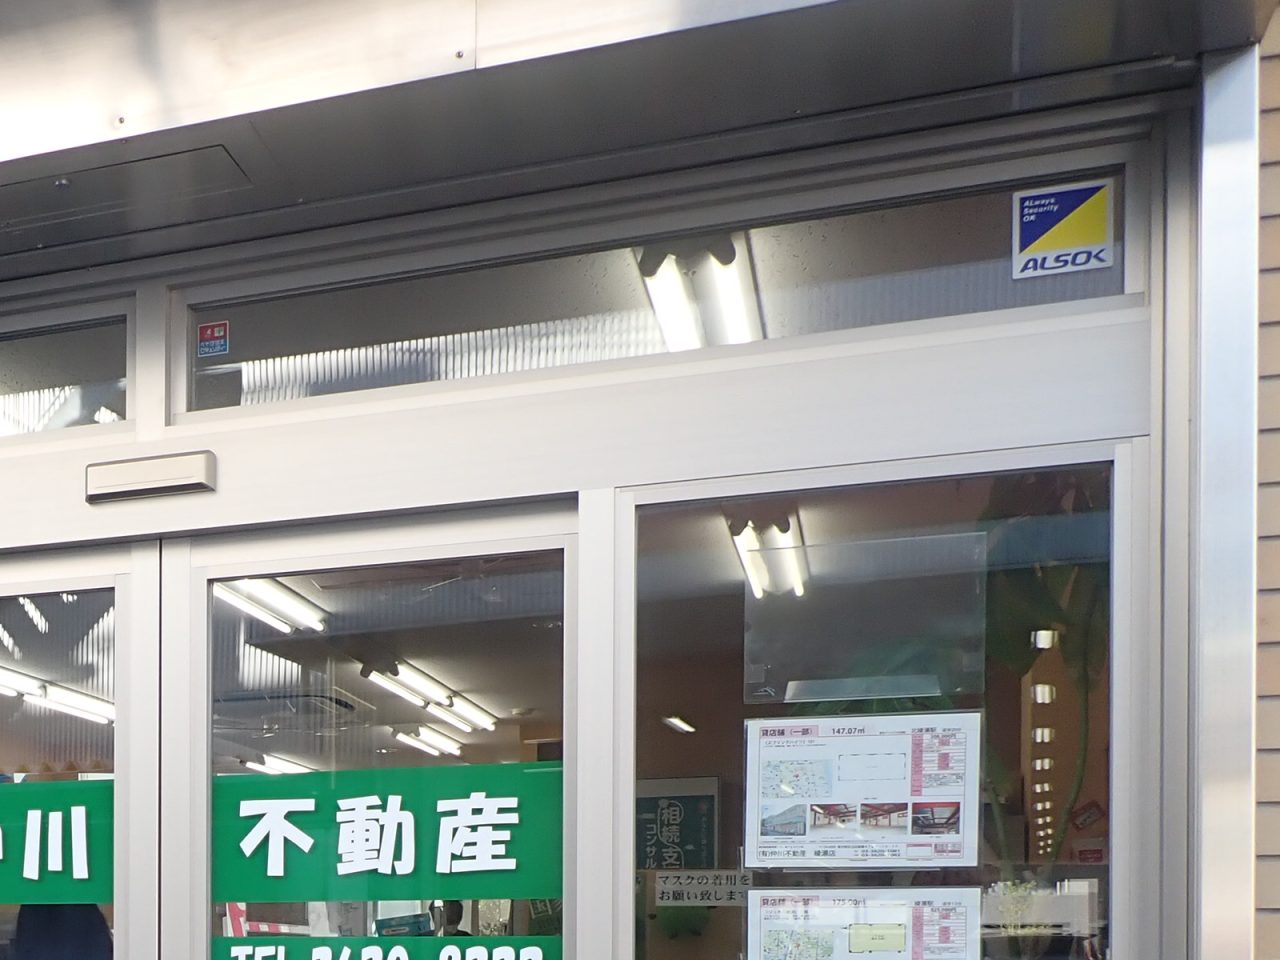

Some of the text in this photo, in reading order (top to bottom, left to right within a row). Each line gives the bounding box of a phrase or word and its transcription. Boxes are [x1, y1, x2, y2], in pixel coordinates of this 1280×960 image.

[1020, 248, 1106, 273] ALSOK
[238, 792, 520, 877] 不動産
[661, 806, 681, 868] 相続支
